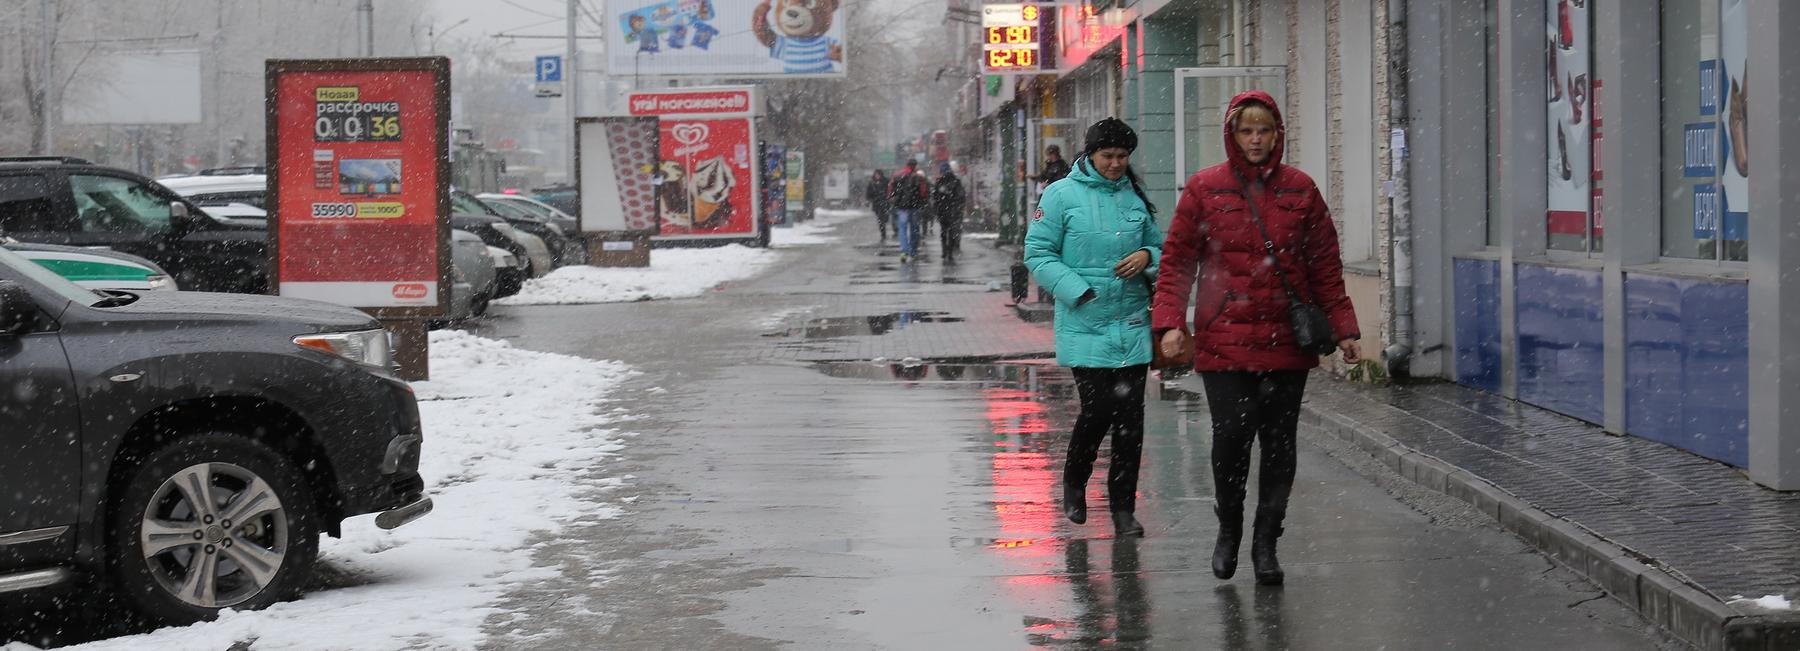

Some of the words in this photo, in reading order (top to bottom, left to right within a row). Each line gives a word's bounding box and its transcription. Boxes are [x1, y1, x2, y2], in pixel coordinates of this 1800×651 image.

[319, 90, 356, 99] Новая
[317, 102, 400, 117] рассрочка
[371, 116, 400, 137] 36
[313, 204, 355, 217] 35990
